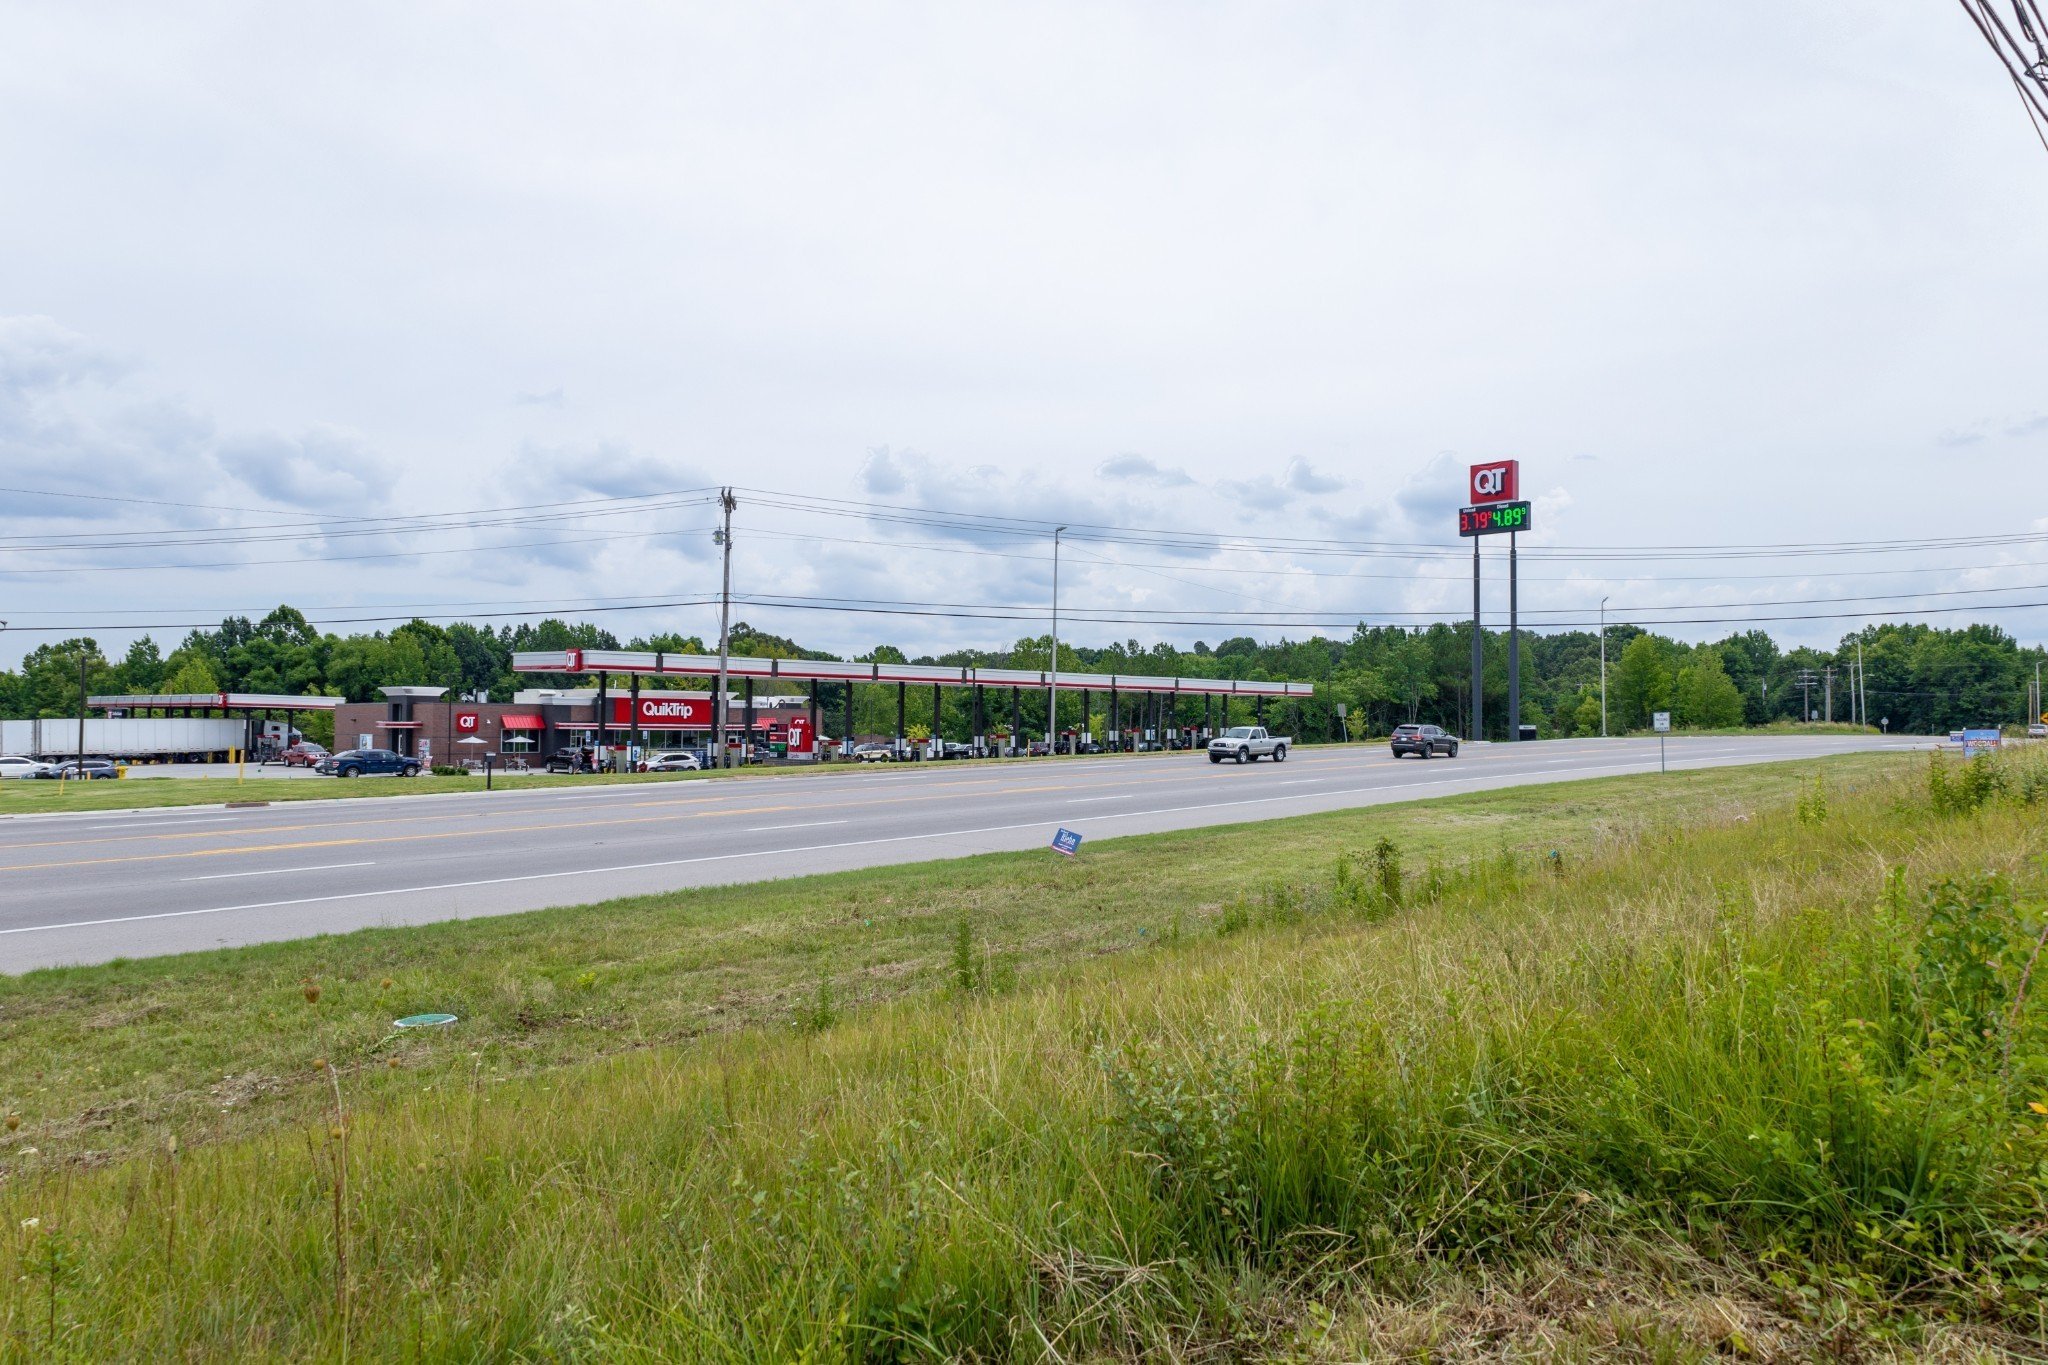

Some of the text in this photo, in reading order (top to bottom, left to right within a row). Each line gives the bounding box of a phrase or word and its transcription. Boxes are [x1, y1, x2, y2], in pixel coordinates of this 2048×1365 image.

[1474, 467, 1506, 494] QT
[567, 653, 576, 667] QT
[643, 701, 693, 719] QuikTrip
[460, 716, 475, 728] QT
[788, 728, 802, 746] QT
